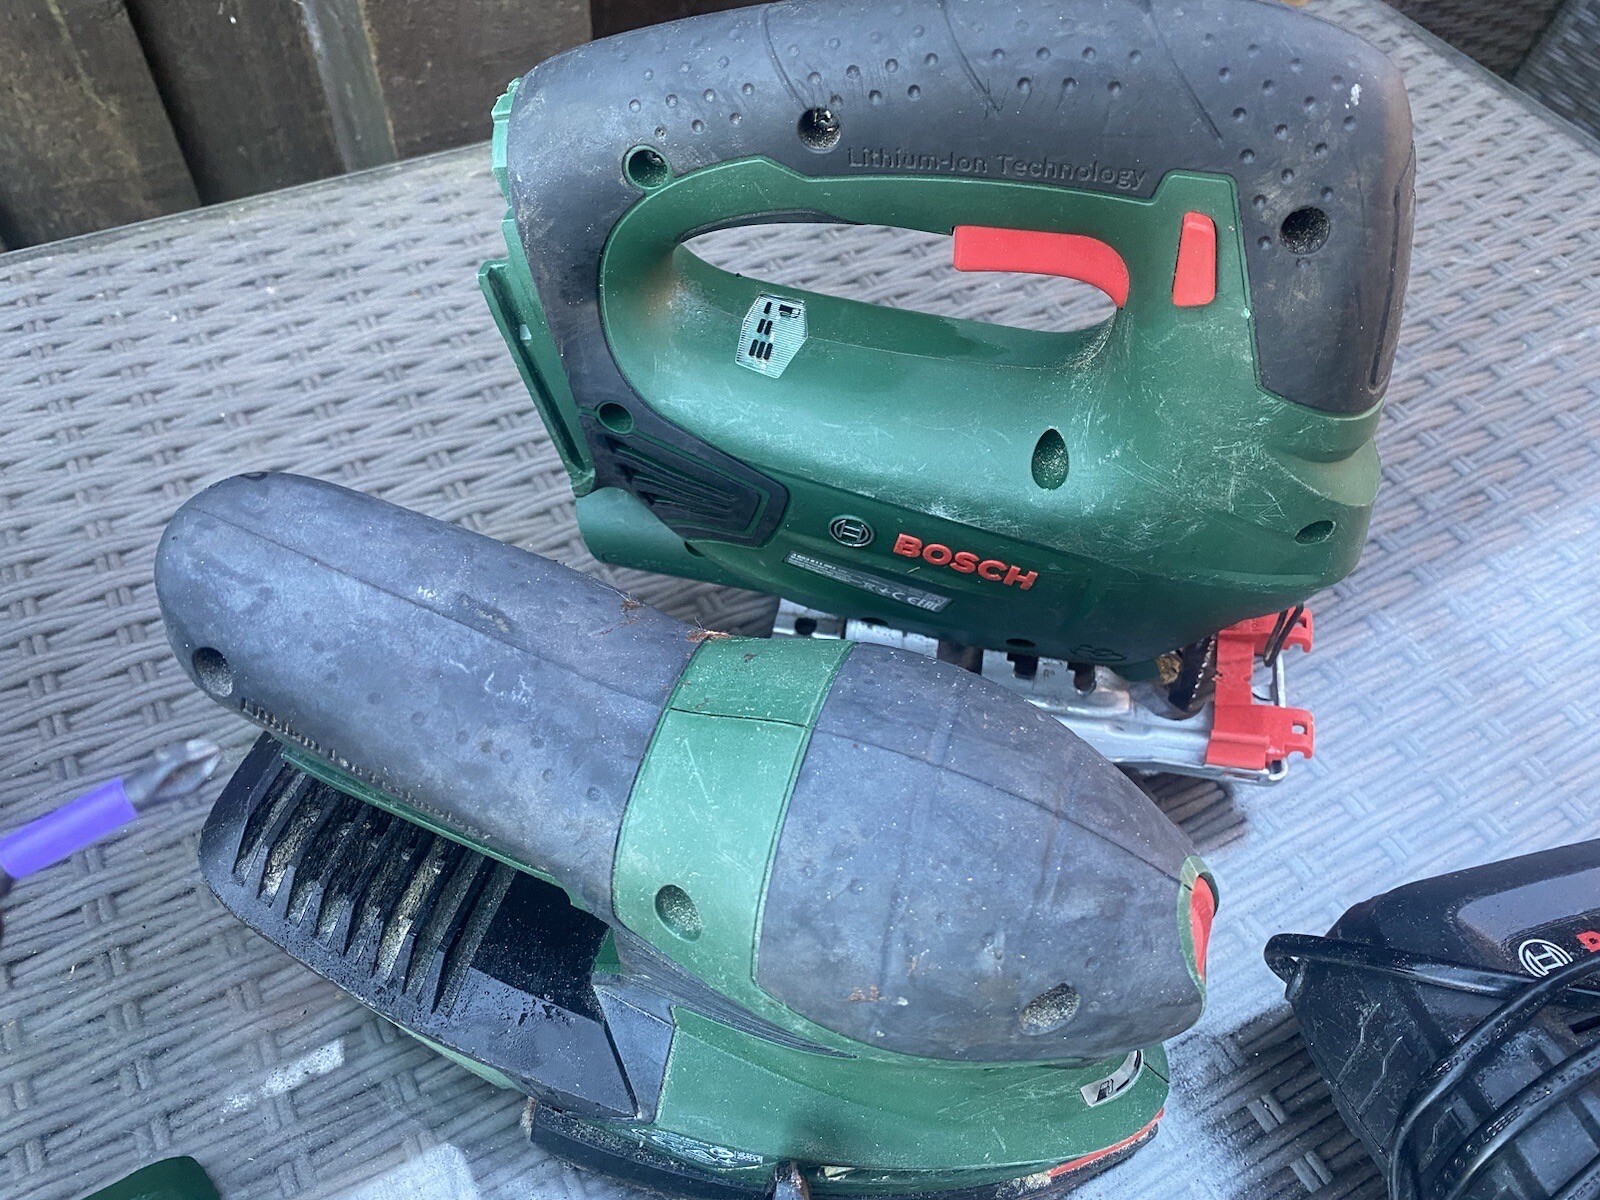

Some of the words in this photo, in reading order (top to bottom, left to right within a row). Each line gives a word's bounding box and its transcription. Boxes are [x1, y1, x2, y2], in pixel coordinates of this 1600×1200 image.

[847, 147, 988, 174] Lithium-Ion
[997, 154, 1145, 189] Technology
[892, 533, 1038, 590] BOSCH
